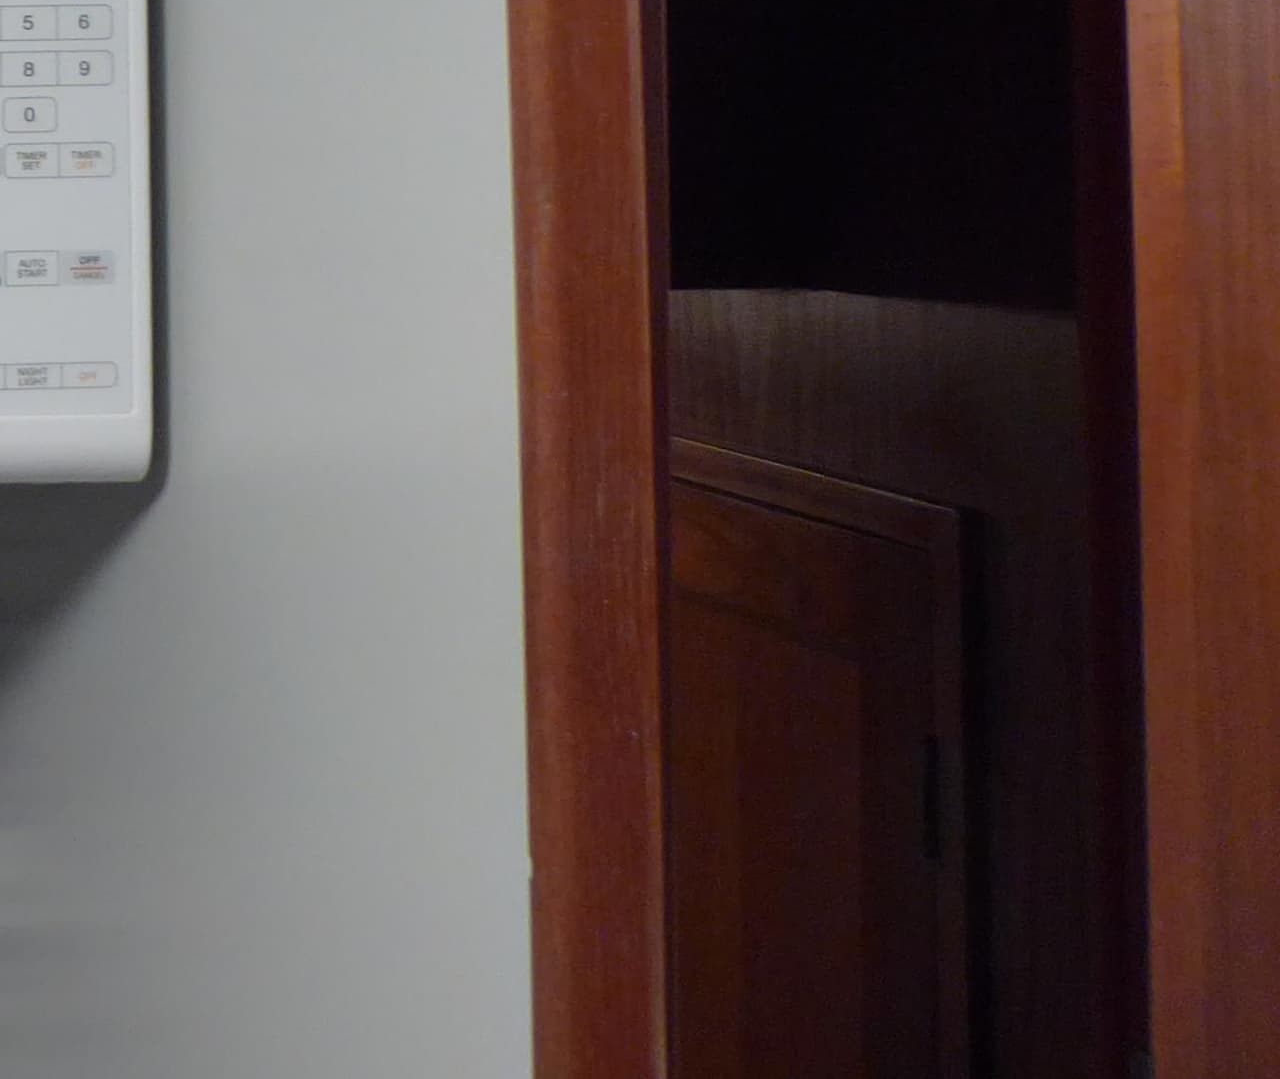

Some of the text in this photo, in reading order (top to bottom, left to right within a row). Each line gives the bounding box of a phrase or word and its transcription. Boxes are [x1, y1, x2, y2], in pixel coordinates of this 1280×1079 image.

[22, 16, 33, 30] 5
[78, 15, 90, 29] 6
[23, 62, 34, 77] 8
[79, 61, 90, 76] 9
[24, 107, 34, 122] 0
[17, 151, 47, 160] TIMER
[71, 150, 101, 160] TIMER
[22, 161, 40, 170] SET
[19, 259, 45, 268] AUTO
[78, 256, 100, 265] OFF
[17, 269, 47, 278] START
[74, 272, 104, 280] CANCEL
[17, 367, 48, 377] NIGHT
[18, 377, 48, 386] LIGHT
